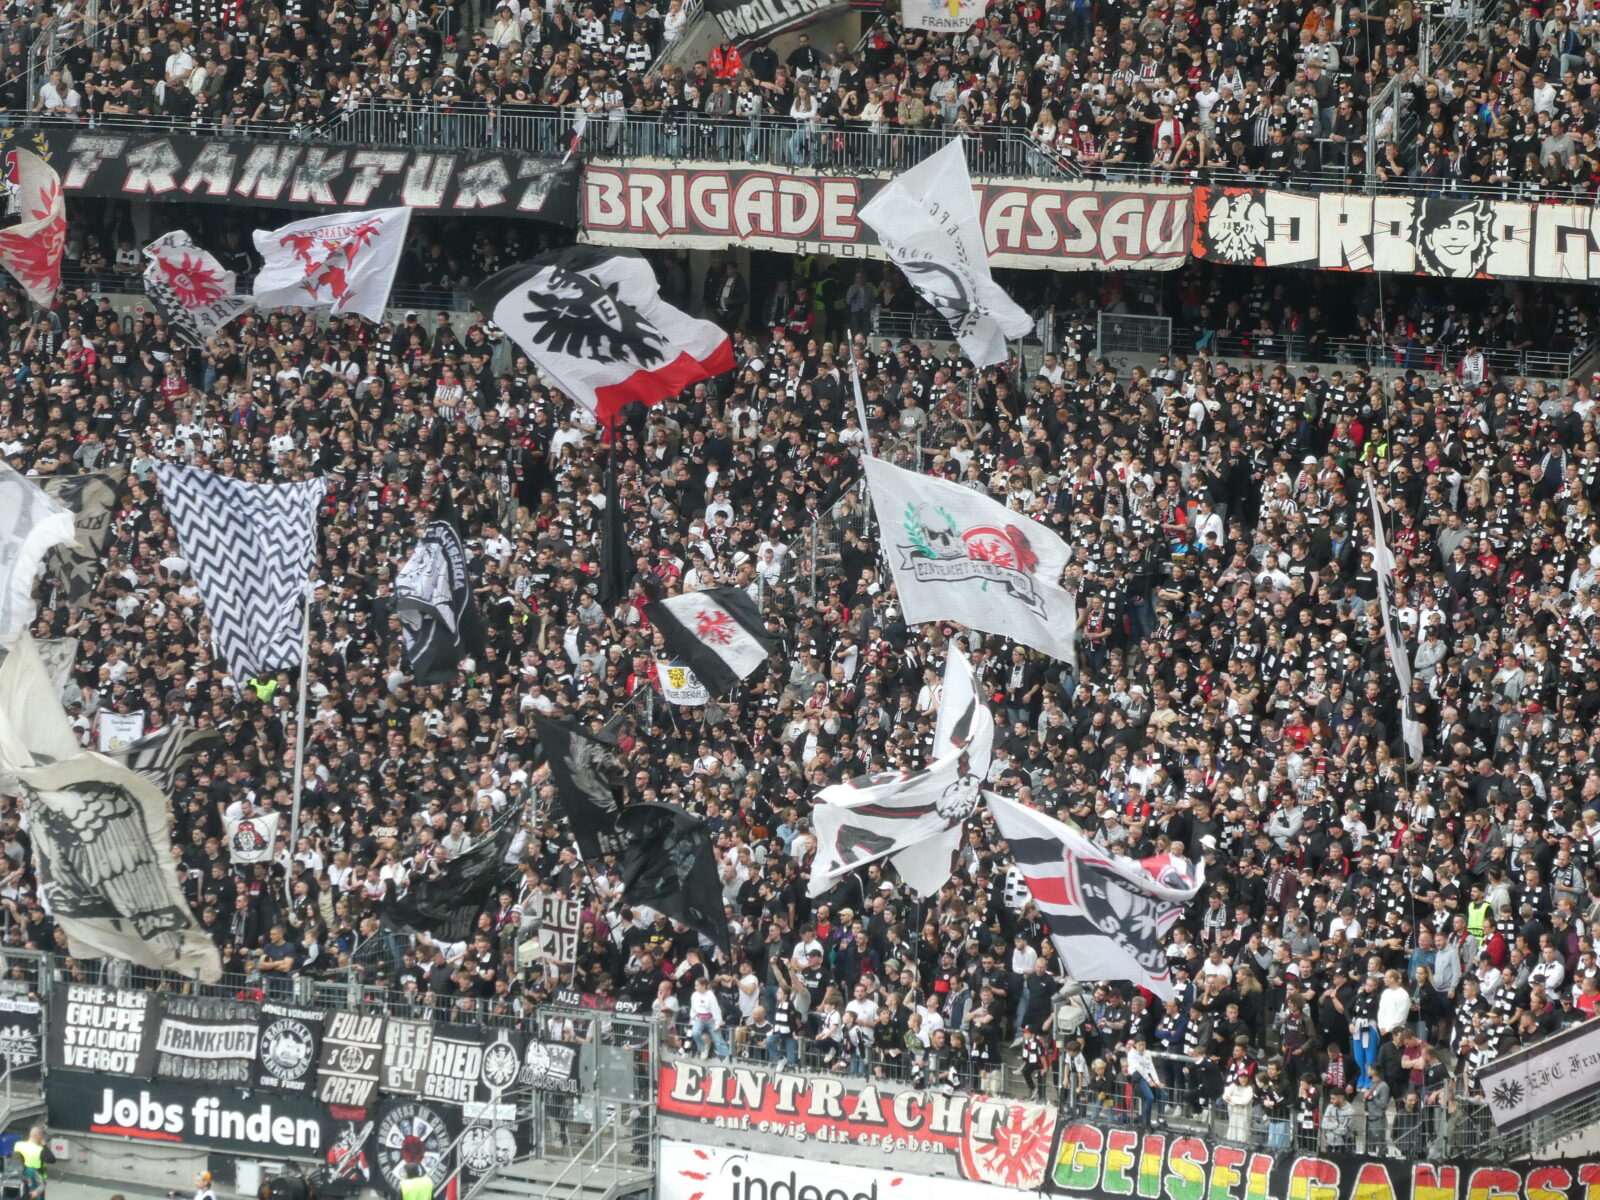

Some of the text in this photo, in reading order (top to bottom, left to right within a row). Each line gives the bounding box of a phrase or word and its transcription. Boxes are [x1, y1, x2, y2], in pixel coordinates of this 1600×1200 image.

[62, 136, 576, 212] FRANKFURT
[583, 166, 862, 240] BRIGADE
[68, 985, 147, 1009] EHRE DER
[66, 1002, 145, 1033] GRUPPE
[328, 1012, 383, 1043] FULDA
[63, 1026, 141, 1052] STADION
[163, 1026, 257, 1053] FRANKFURT
[63, 1045, 139, 1074] VERBOT
[327, 1048, 375, 1071] 3 6
[427, 1041, 482, 1080] RIED
[321, 1076, 374, 1106] CREW
[424, 1073, 478, 1101] GEBIET
[671, 1060, 1008, 1140] EINTRACHT
[93, 1088, 321, 1149] Jobs finden
[715, 1115, 946, 1154] auf ewig dir ergeben
